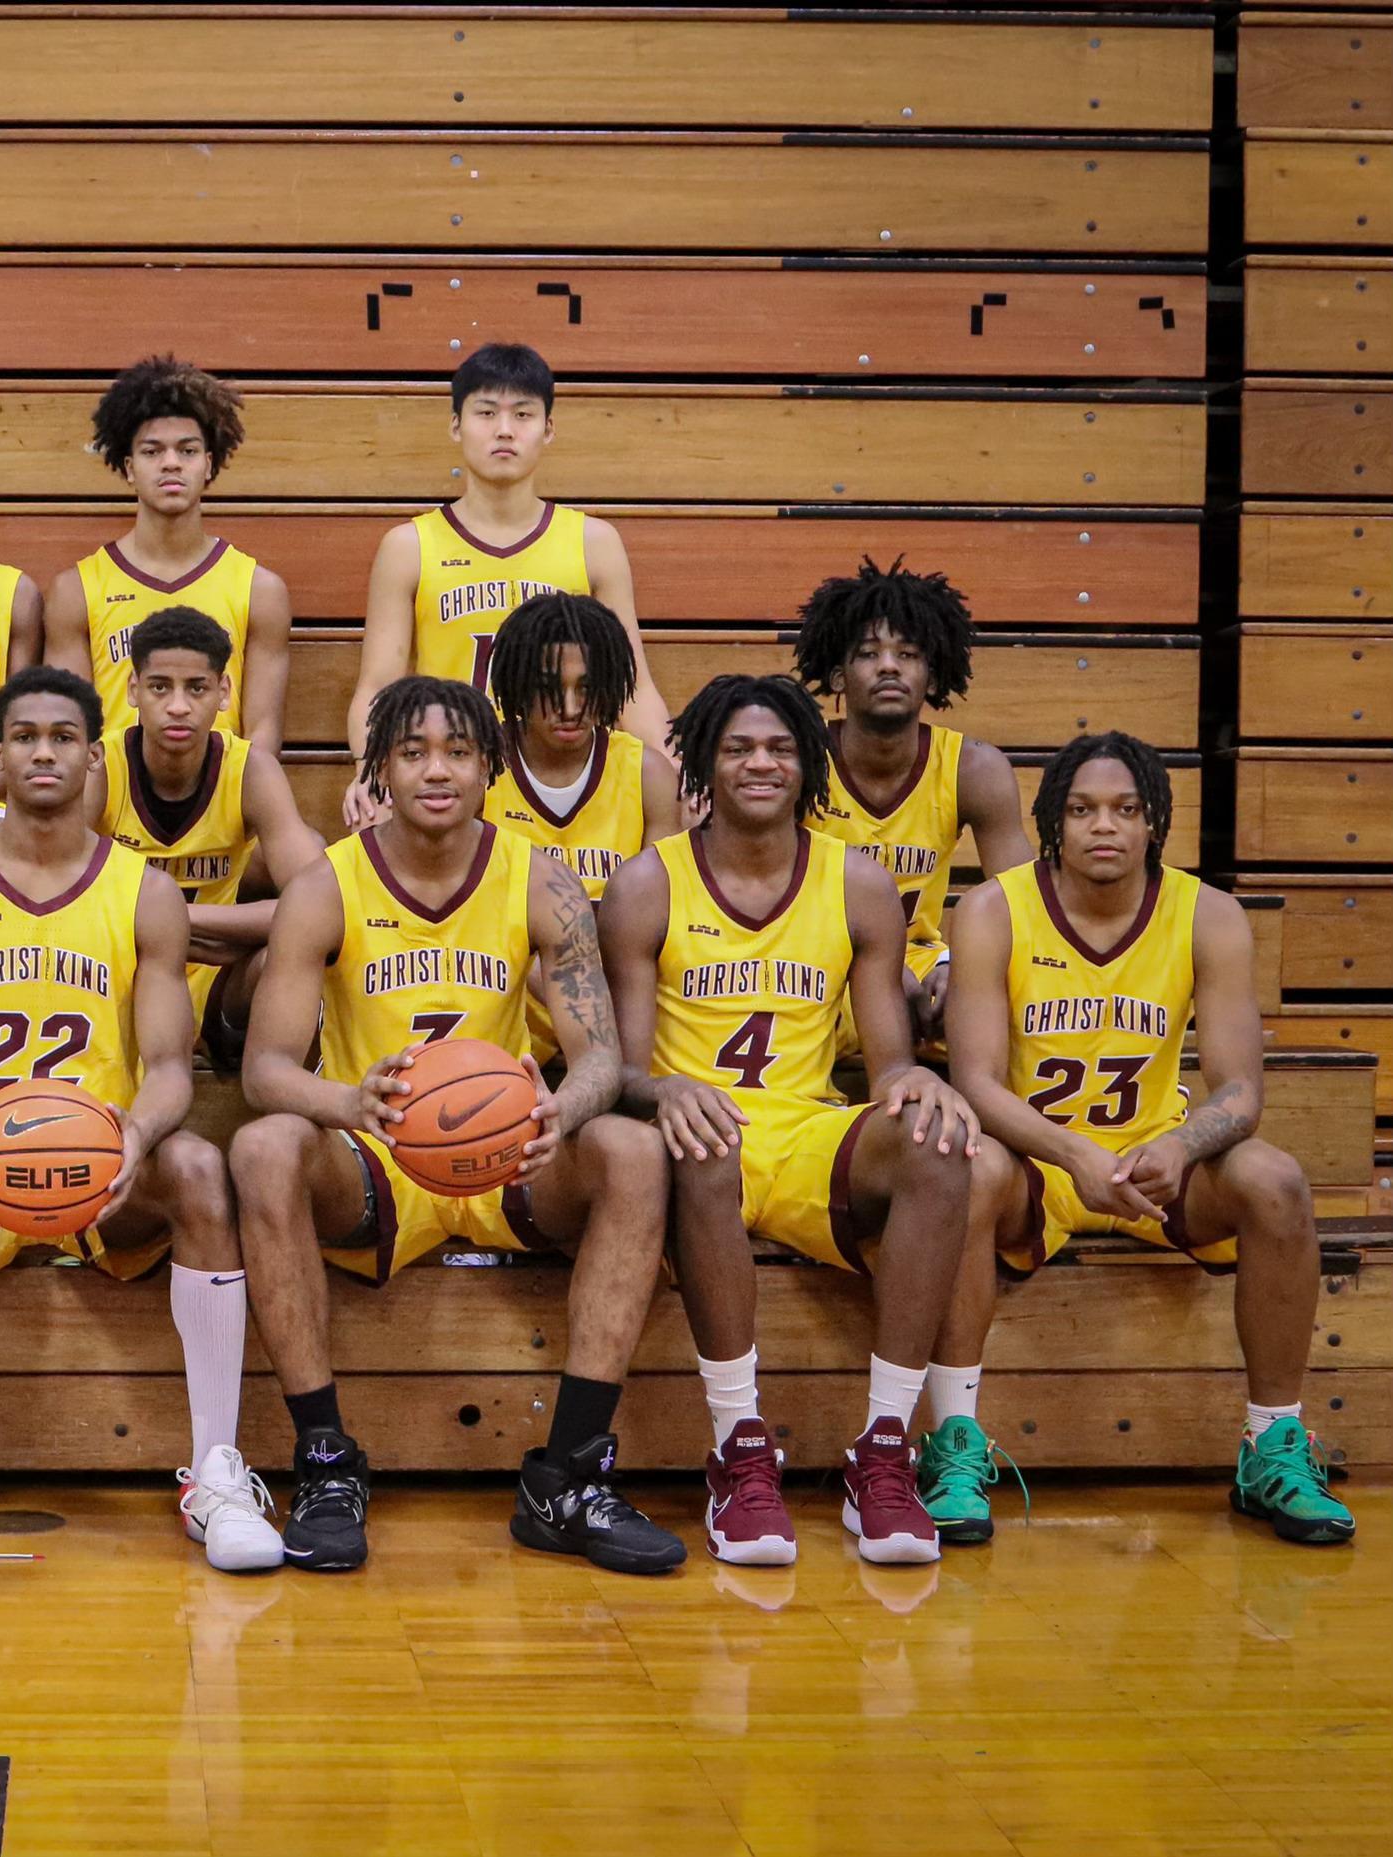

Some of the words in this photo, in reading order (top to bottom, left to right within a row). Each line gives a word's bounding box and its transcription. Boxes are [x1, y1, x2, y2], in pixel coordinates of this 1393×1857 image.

[440, 581, 507, 623] CHRIST
[185, 855, 231, 879] KING
[893, 845, 937, 874] KING
[55, 950, 108, 998] KING
[365, 949, 441, 995] CHRIST
[456, 950, 507, 994] KING
[683, 960, 760, 998] CHRIST
[776, 961, 825, 1003] KING
[1024, 998, 1105, 1034] CHRIST
[1114, 996, 1166, 1038] KING
[715, 1010, 777, 1090] 4
[1027, 1056, 1151, 1128] 23
[5, 1163, 91, 1190] ELITE
[450, 1142, 520, 1174] ELITE
